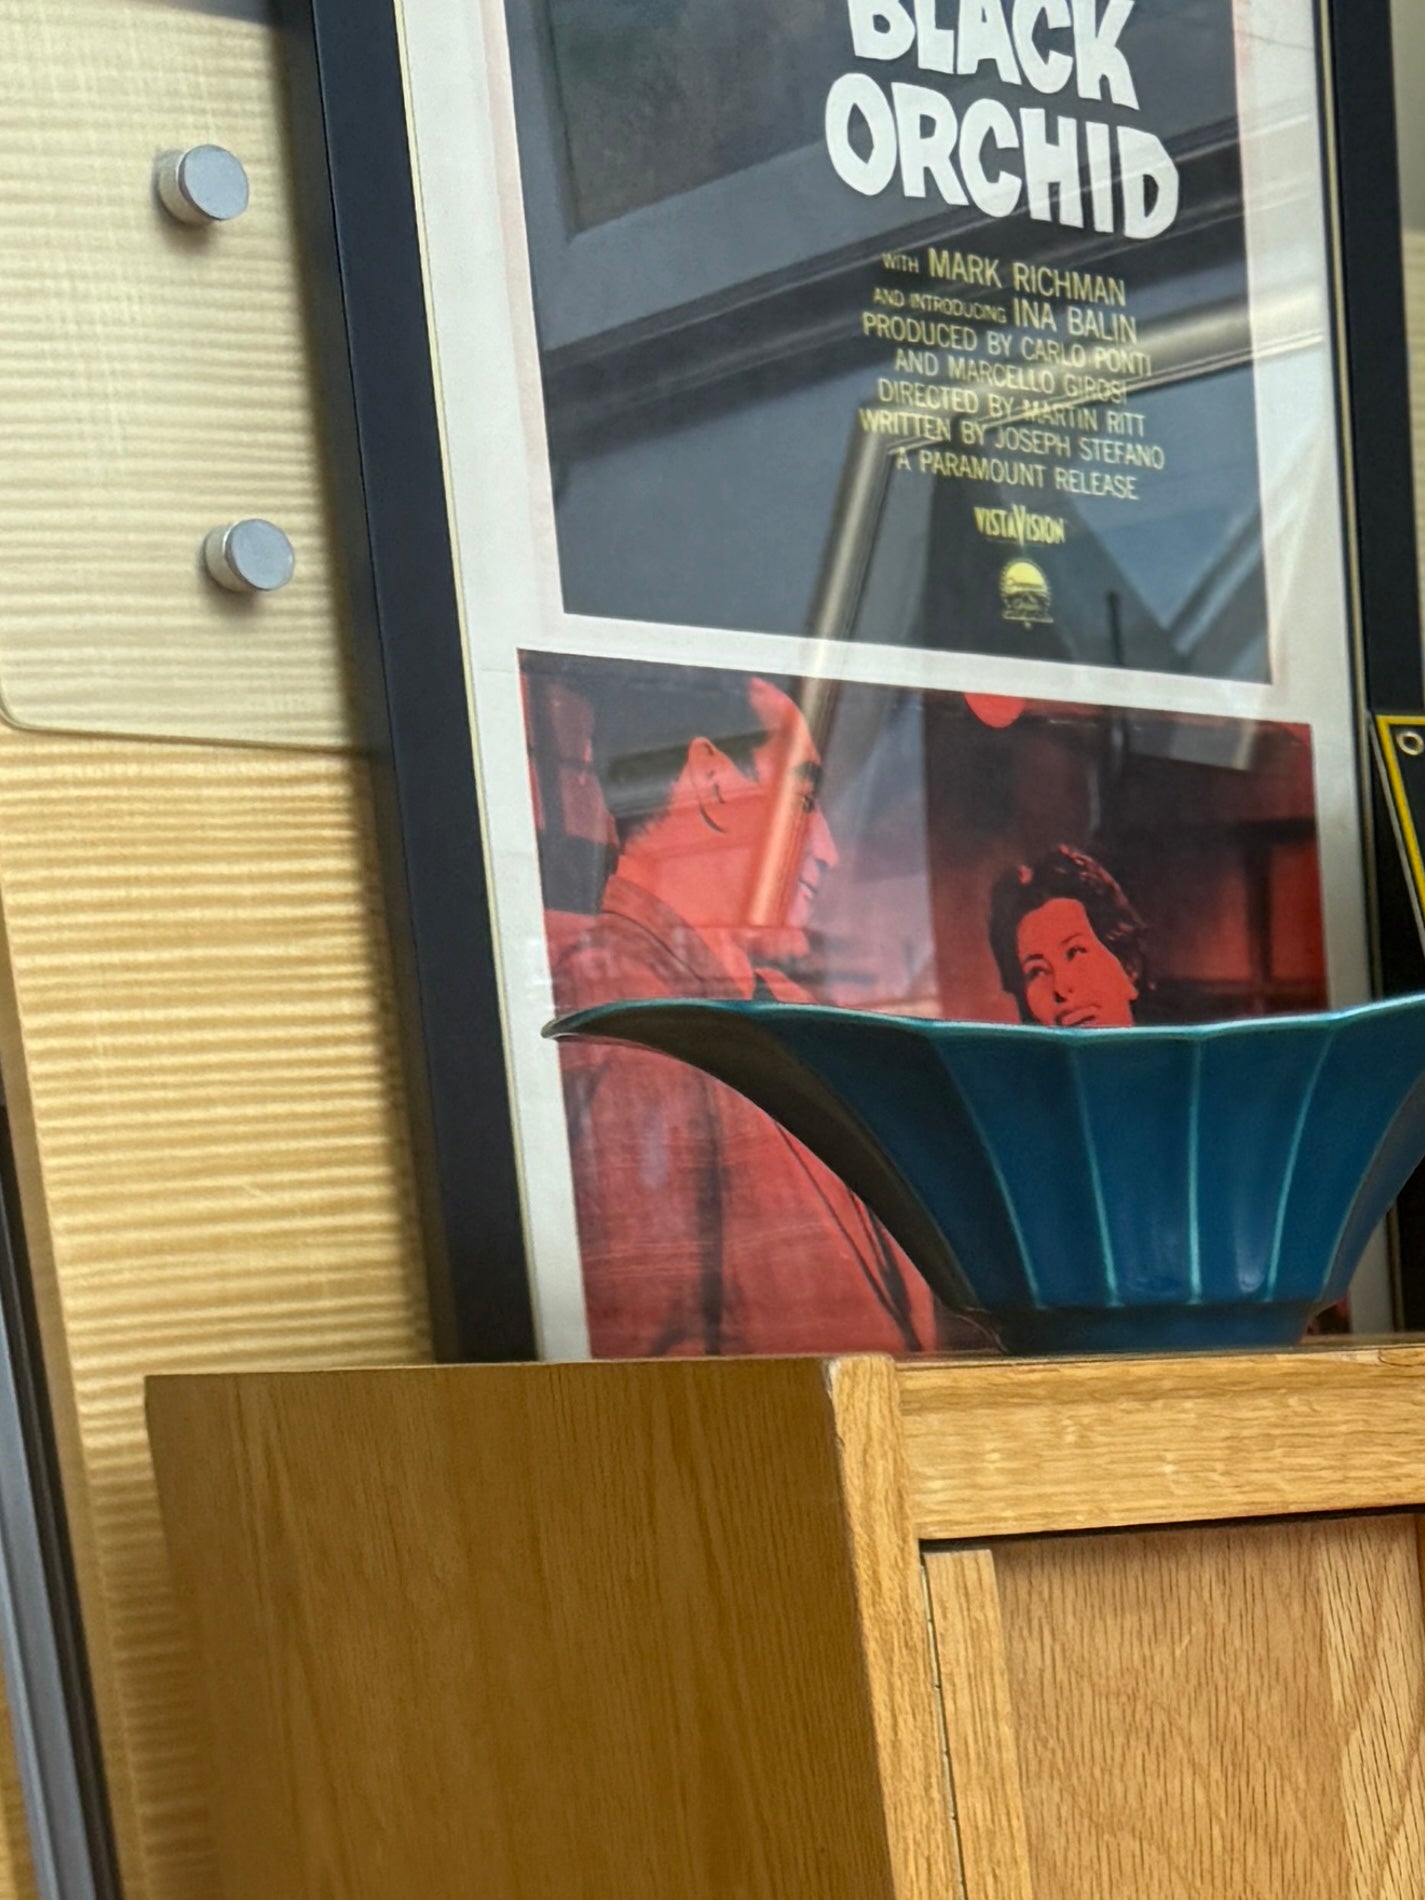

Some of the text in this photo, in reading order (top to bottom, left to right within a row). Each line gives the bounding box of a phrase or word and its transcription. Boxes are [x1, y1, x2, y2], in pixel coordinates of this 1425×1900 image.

[849, 0, 1140, 110] BLACK
[825, 72, 1180, 239] ORCHID
[881, 248, 1126, 306] WITH MARK RICHMAN
[862, 311, 1152, 376] PRODUCED BY CARLO PONTI
[873, 288, 1137, 344] AND INTRODUCING INA BALIN
[895, 349, 939, 376] AND
[949, 359, 1055, 393] MARCELLO
[878, 378, 1146, 437] DIRECTED BY MARTIN RITT
[859, 408, 1165, 470] WRITTEN BY JOSEPH STEFANO
[896, 446, 1140, 500] A PARAMOUNT RELEASE
